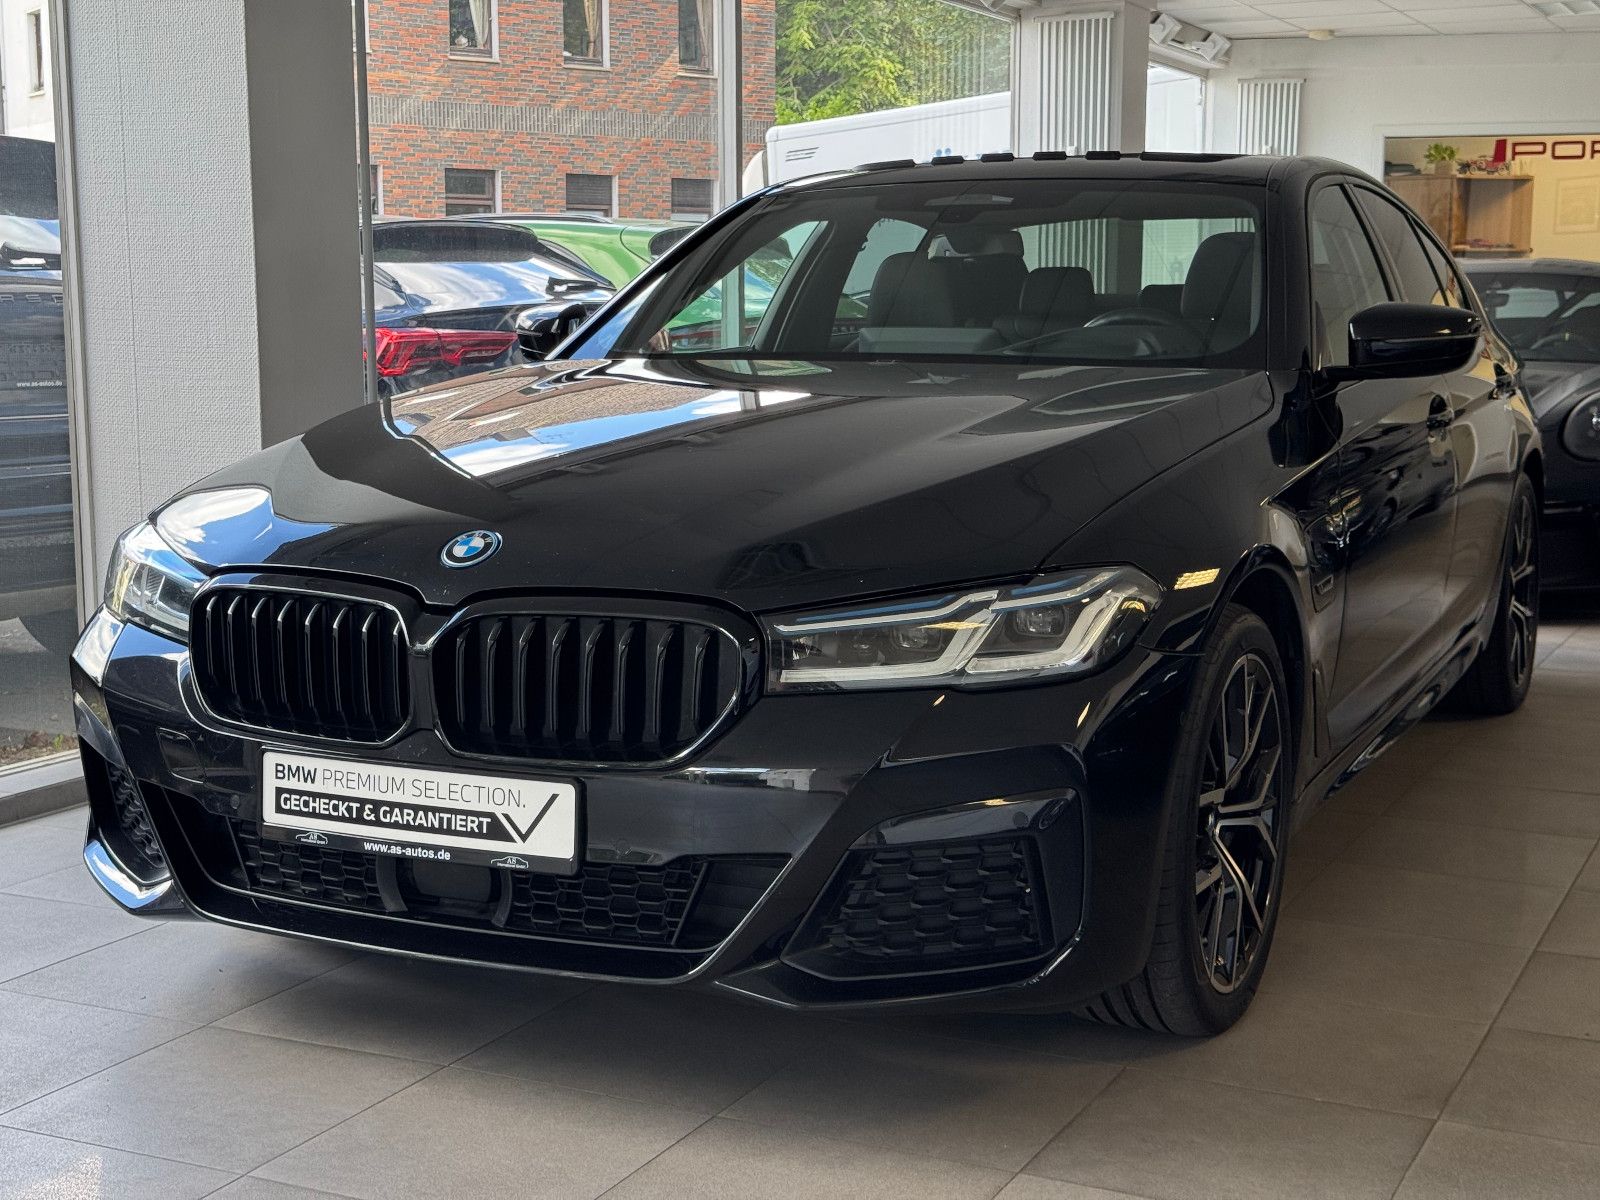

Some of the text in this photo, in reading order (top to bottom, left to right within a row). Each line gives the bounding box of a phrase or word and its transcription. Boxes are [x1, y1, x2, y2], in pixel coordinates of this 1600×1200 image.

[1512, 140, 1600, 161] PO
[275, 762, 526, 809] BMW PREMIUM SELECTION.
[280, 792, 492, 834] GECHECKT & GARANTIERT
[363, 841, 452, 861] www.as-autos.de
